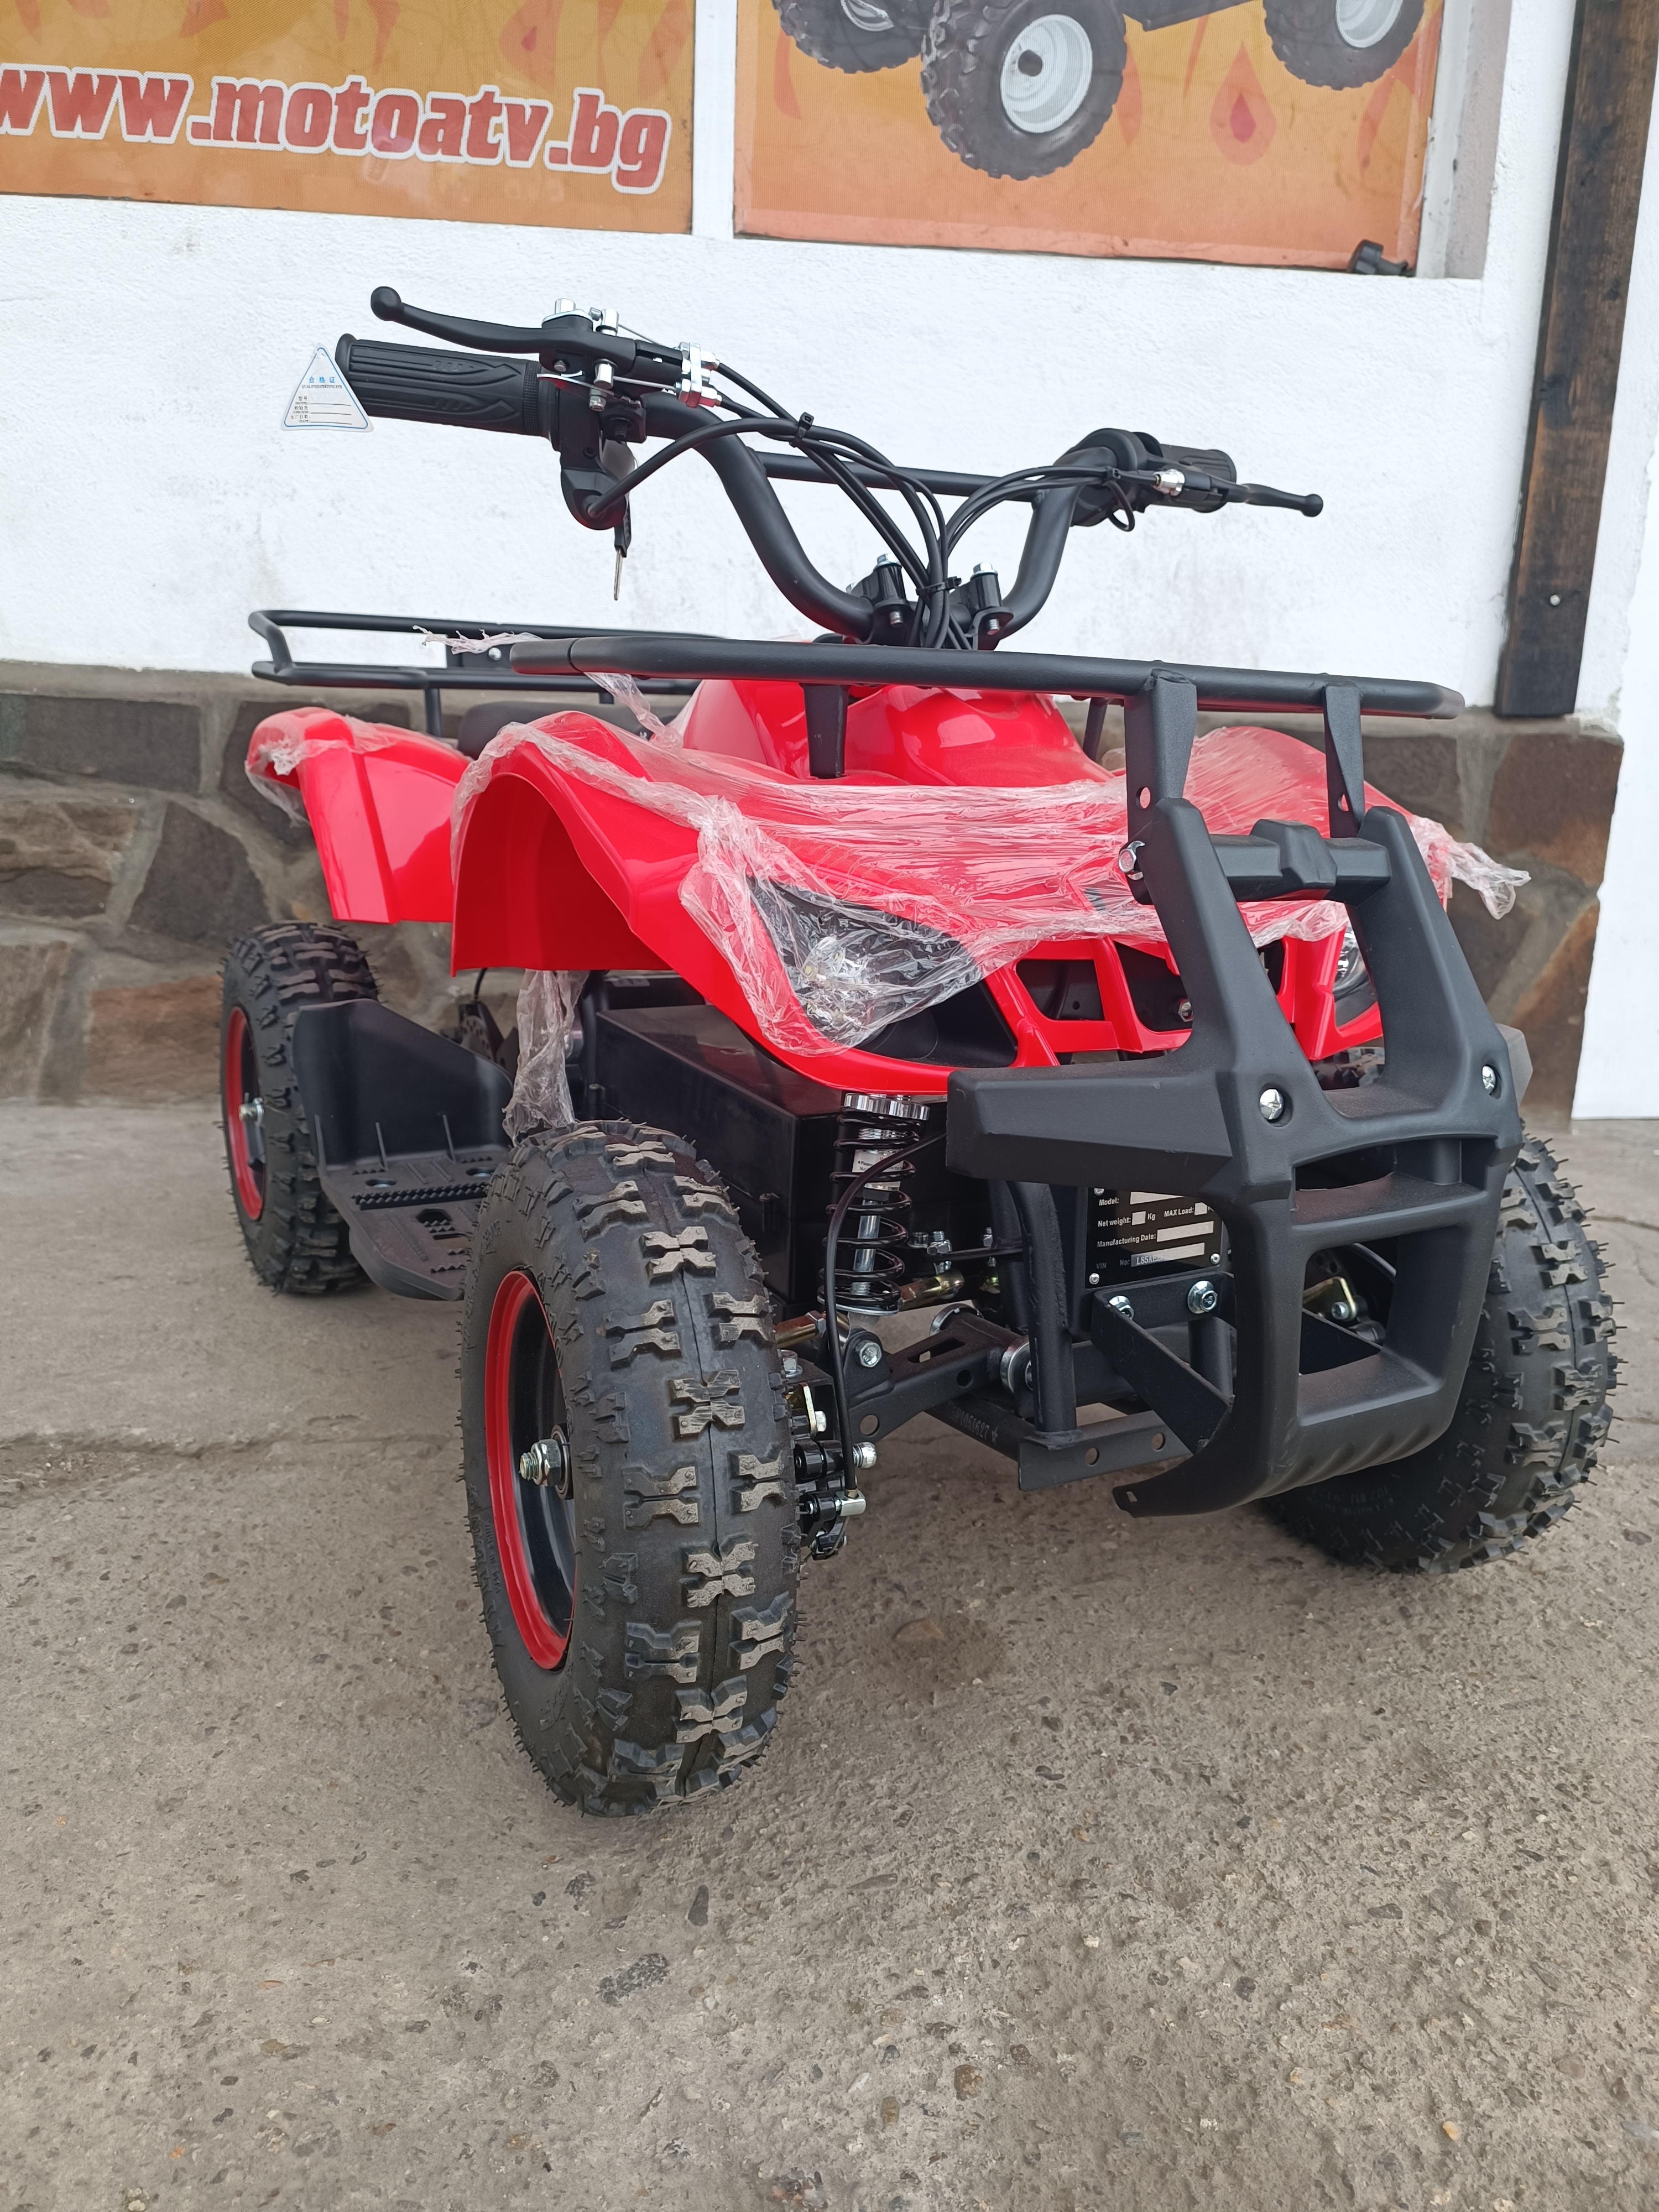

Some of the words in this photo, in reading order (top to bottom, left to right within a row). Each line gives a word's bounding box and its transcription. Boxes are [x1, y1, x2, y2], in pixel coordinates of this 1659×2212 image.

[1099, 1197, 1119, 1206] Model:
[1164, 1209, 1177, 1217] MAX
[1178, 1207, 1194, 1215] Load:
[1109, 1217, 1131, 1226] weight:
[1147, 1213, 1156, 1221] Kg
[1097, 1235, 1140, 1248] Manufacturing
[1140, 1233, 1156, 1241] Date:
